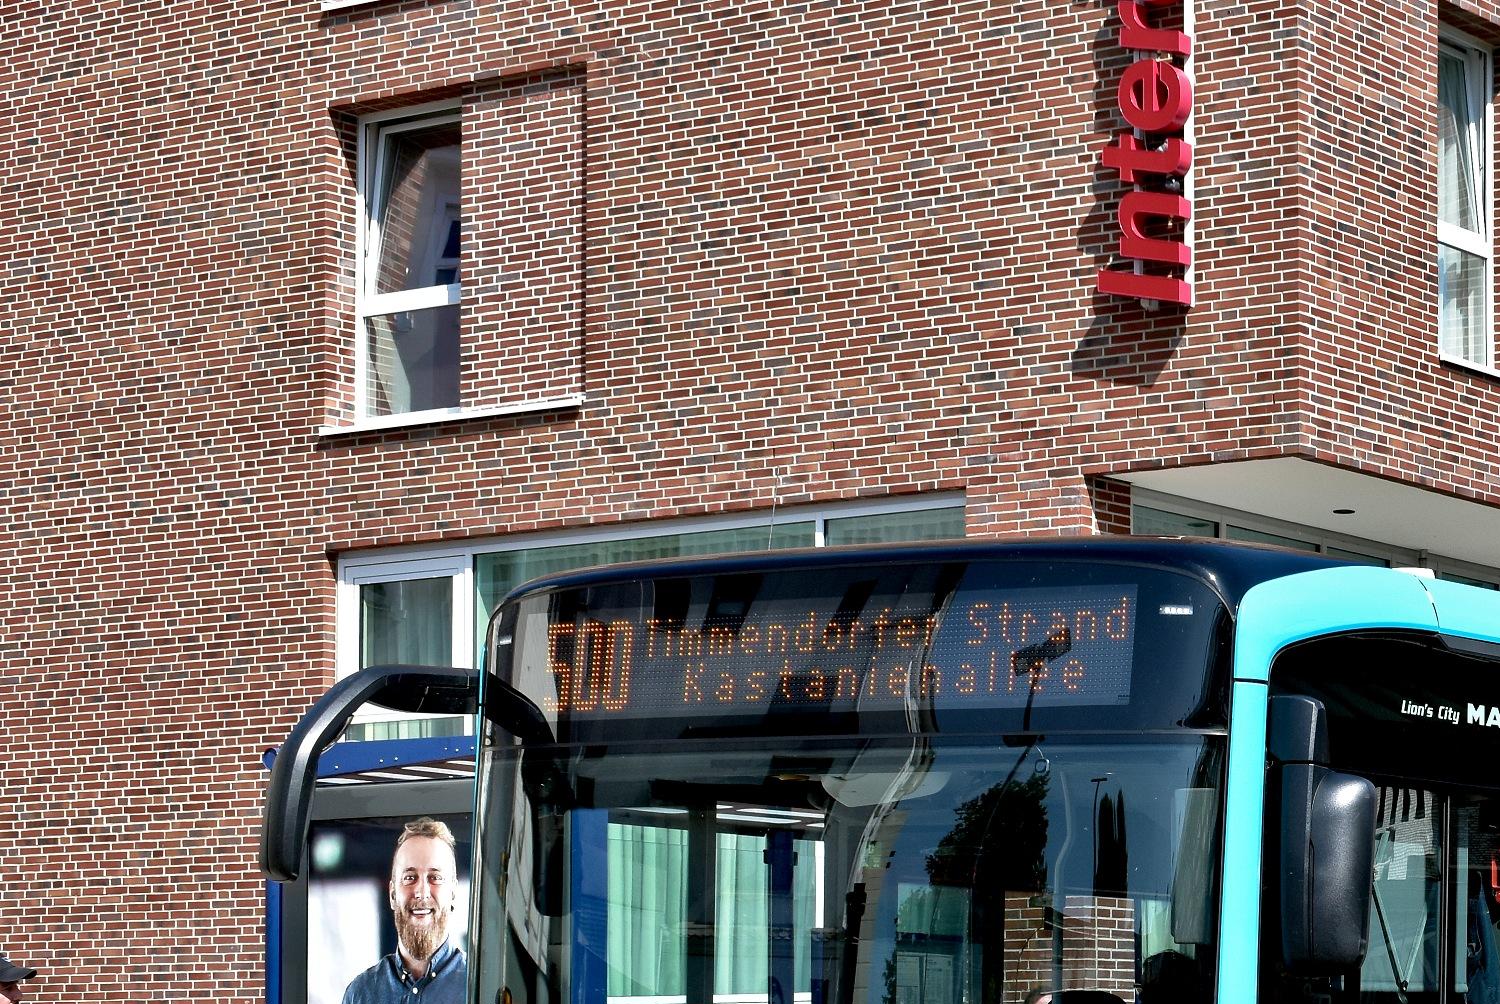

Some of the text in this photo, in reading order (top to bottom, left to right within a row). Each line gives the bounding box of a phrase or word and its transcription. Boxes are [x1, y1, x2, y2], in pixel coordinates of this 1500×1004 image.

[646, 596, 1130, 657] Timmendorfer Strand
[544, 620, 634, 712] 500
[683, 651, 1085, 702] Kastanienallee
[1400, 700, 1434, 718] Lion's
[1437, 705, 1460, 725] City
